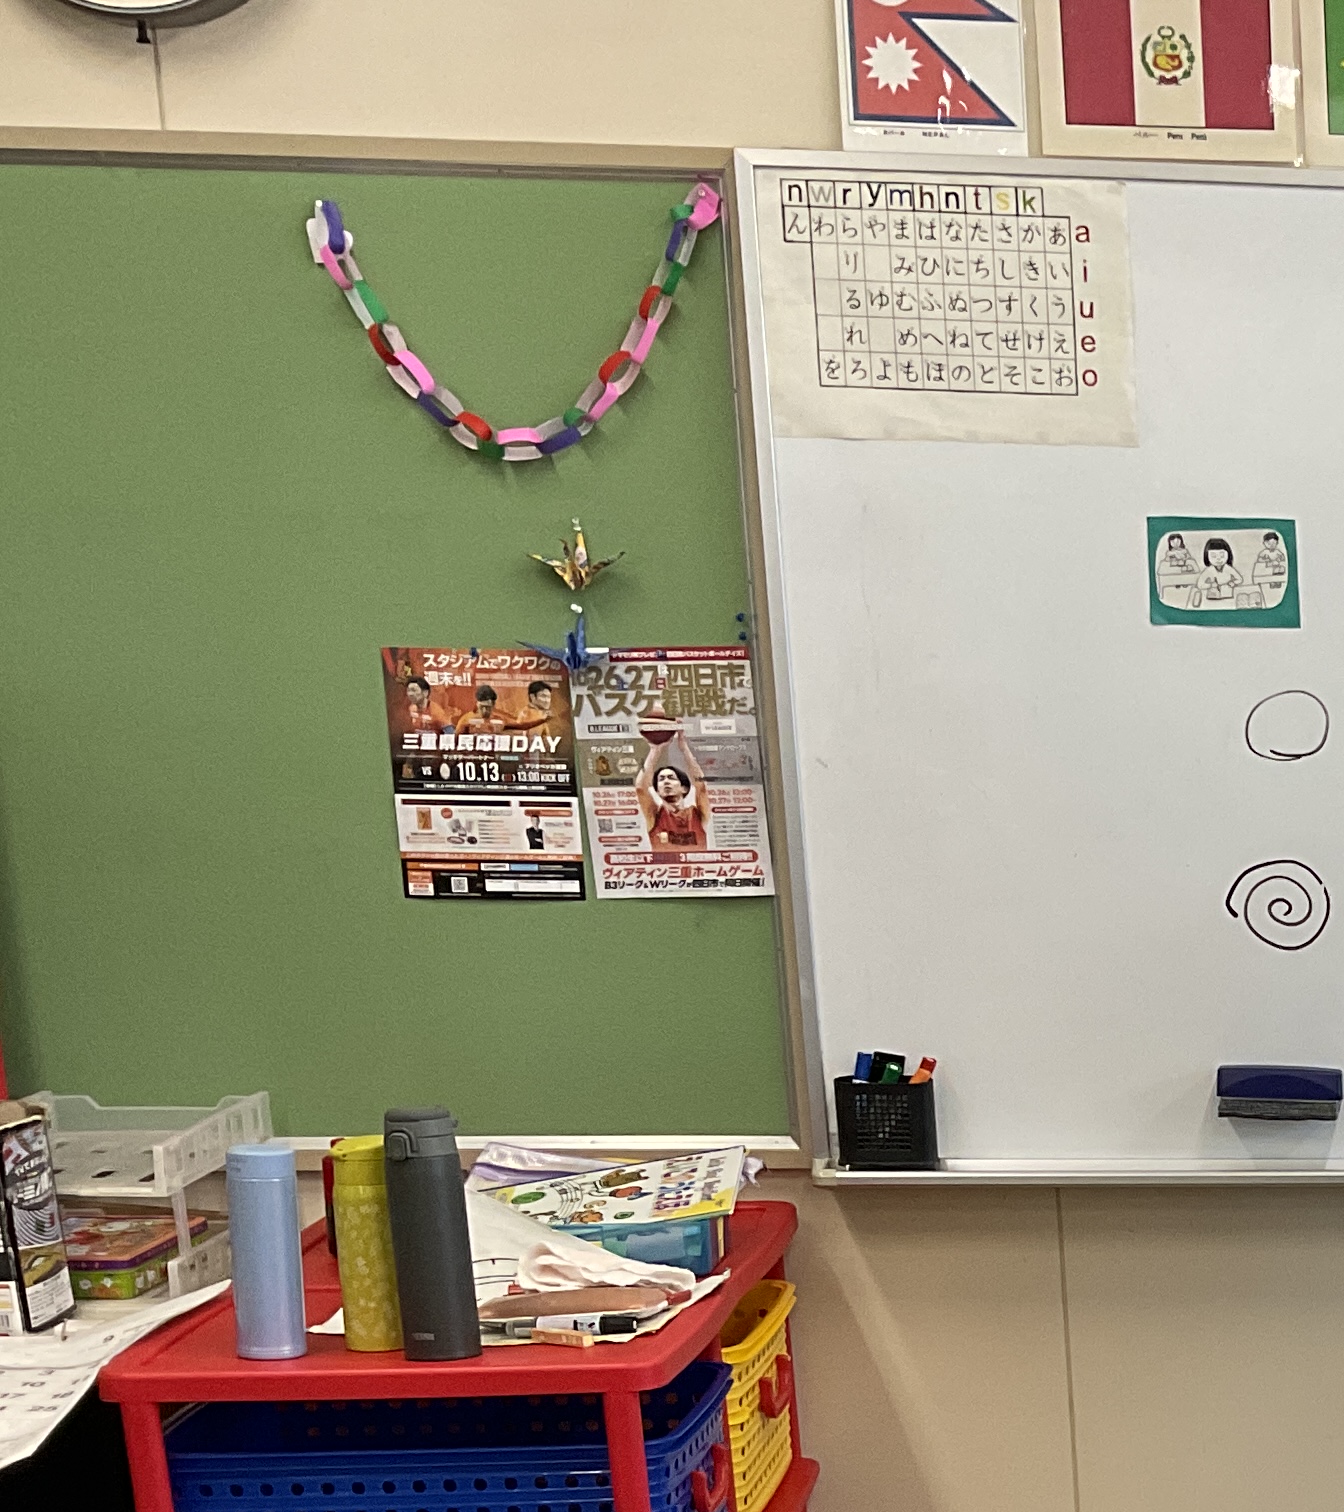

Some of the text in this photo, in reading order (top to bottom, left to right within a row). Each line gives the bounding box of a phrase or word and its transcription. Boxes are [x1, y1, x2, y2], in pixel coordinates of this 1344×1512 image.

[788, 183, 1036, 213] n w r y m h n t s k
[788, 212, 1067, 246] ん わ ら や ま は な た さ か あ
[1075, 225, 1090, 243] a
[844, 252, 1069, 281] り み ひ に ち し き い
[1082, 260, 1088, 283] i
[846, 289, 1066, 318] る ゆ む ふ ぬ つ す く う
[1080, 300, 1094, 319] u
[846, 326, 1070, 354] れ め へ ね て せ け え
[1081, 334, 1096, 352] e
[824, 360, 1073, 387] を ろ よ も ほ の と そ こ お
[1083, 369, 1098, 386] o
[457, 762, 499, 782] 10.13
